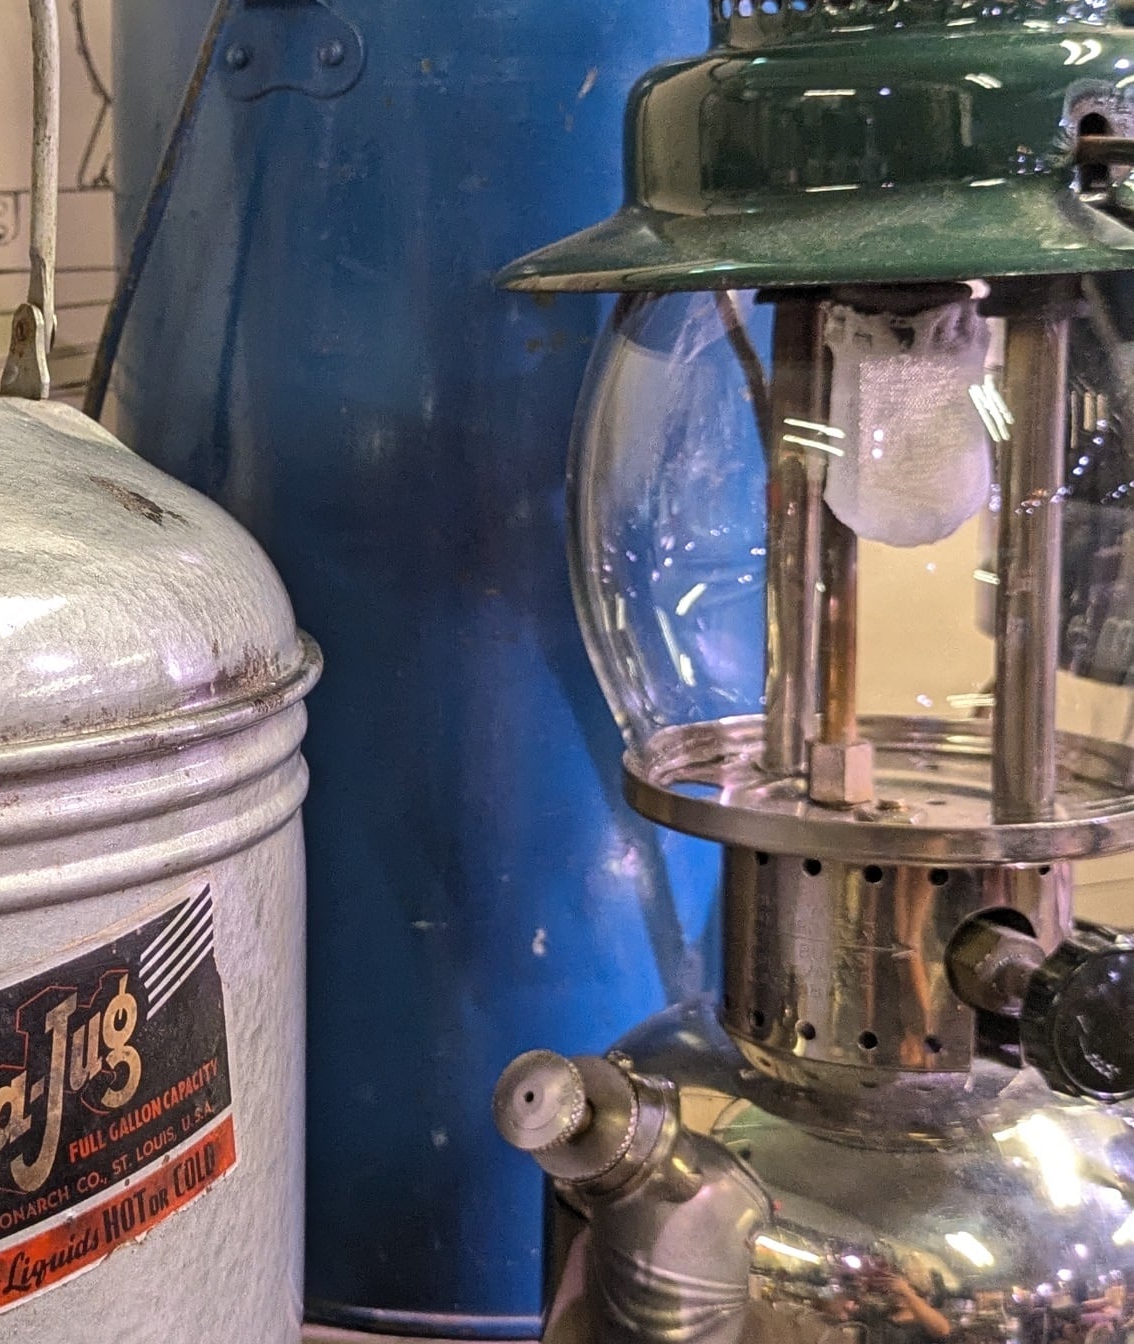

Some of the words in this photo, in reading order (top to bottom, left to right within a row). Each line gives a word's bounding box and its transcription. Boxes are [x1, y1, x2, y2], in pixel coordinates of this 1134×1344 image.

[69, 1129, 107, 1164] FULL
[108, 1096, 164, 1143] GALLON
[163, 1058, 219, 1110] CAPACITY
[2, 1227, 99, 1293] Liquids
[102, 1186, 149, 1243] HOT
[172, 1140, 216, 1198] COLD
